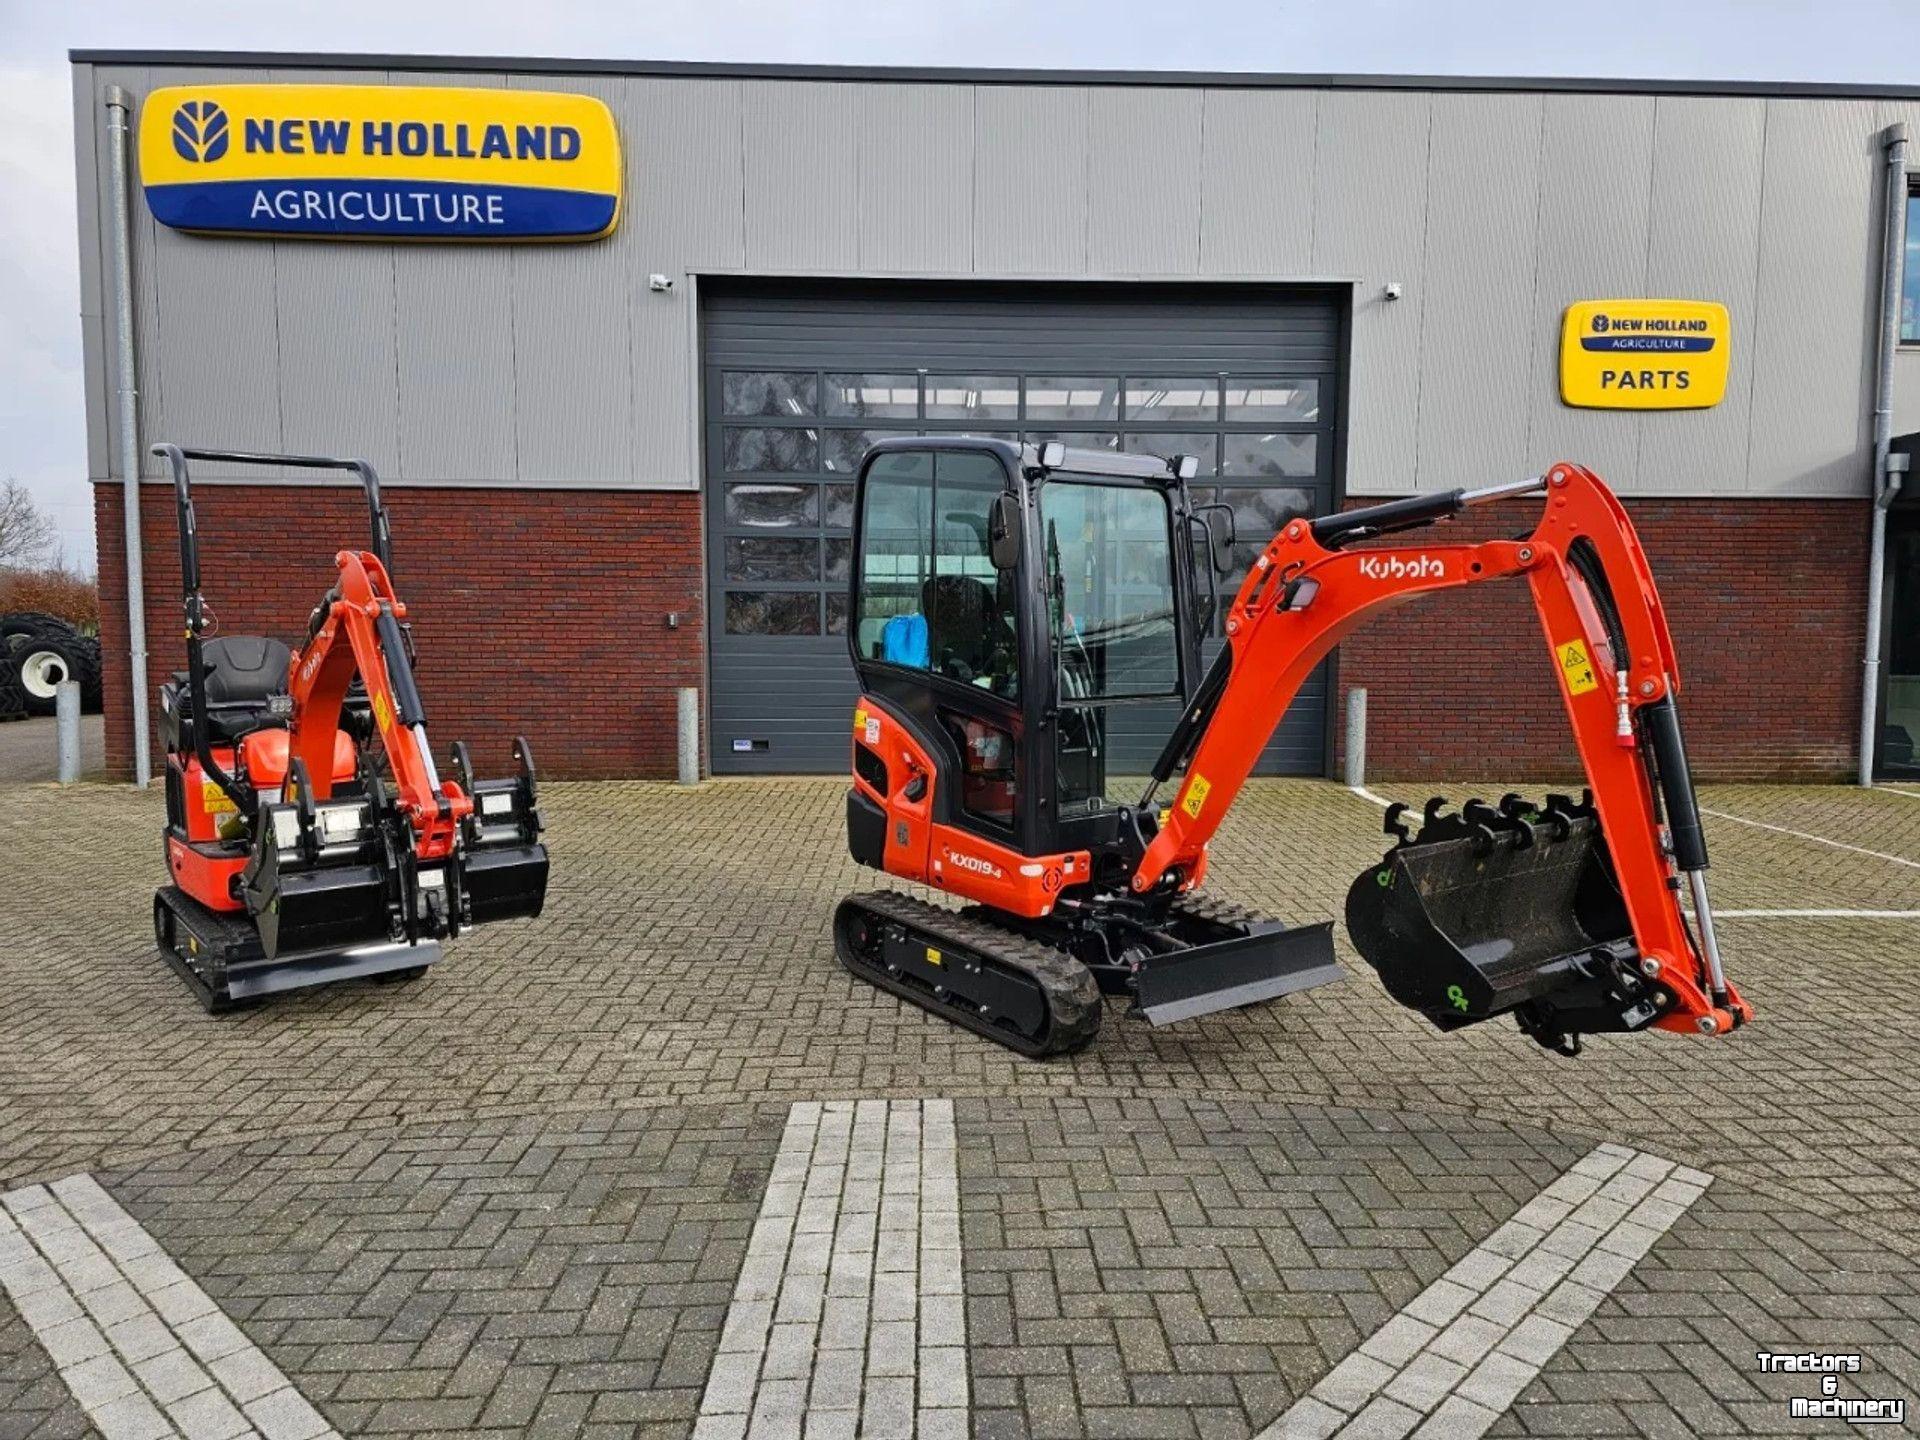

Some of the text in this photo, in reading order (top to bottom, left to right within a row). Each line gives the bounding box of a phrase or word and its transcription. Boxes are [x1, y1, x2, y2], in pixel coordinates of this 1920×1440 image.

[244, 118, 581, 160] NEW HOLLAND
[250, 189, 504, 224] AGRICULTURE
[1612, 319, 1707, 331] NEW HOLLAND
[1612, 339, 1686, 349] AGRICULTURE
[1601, 370, 1690, 389] PARTS
[1360, 554, 1445, 579] Kubota
